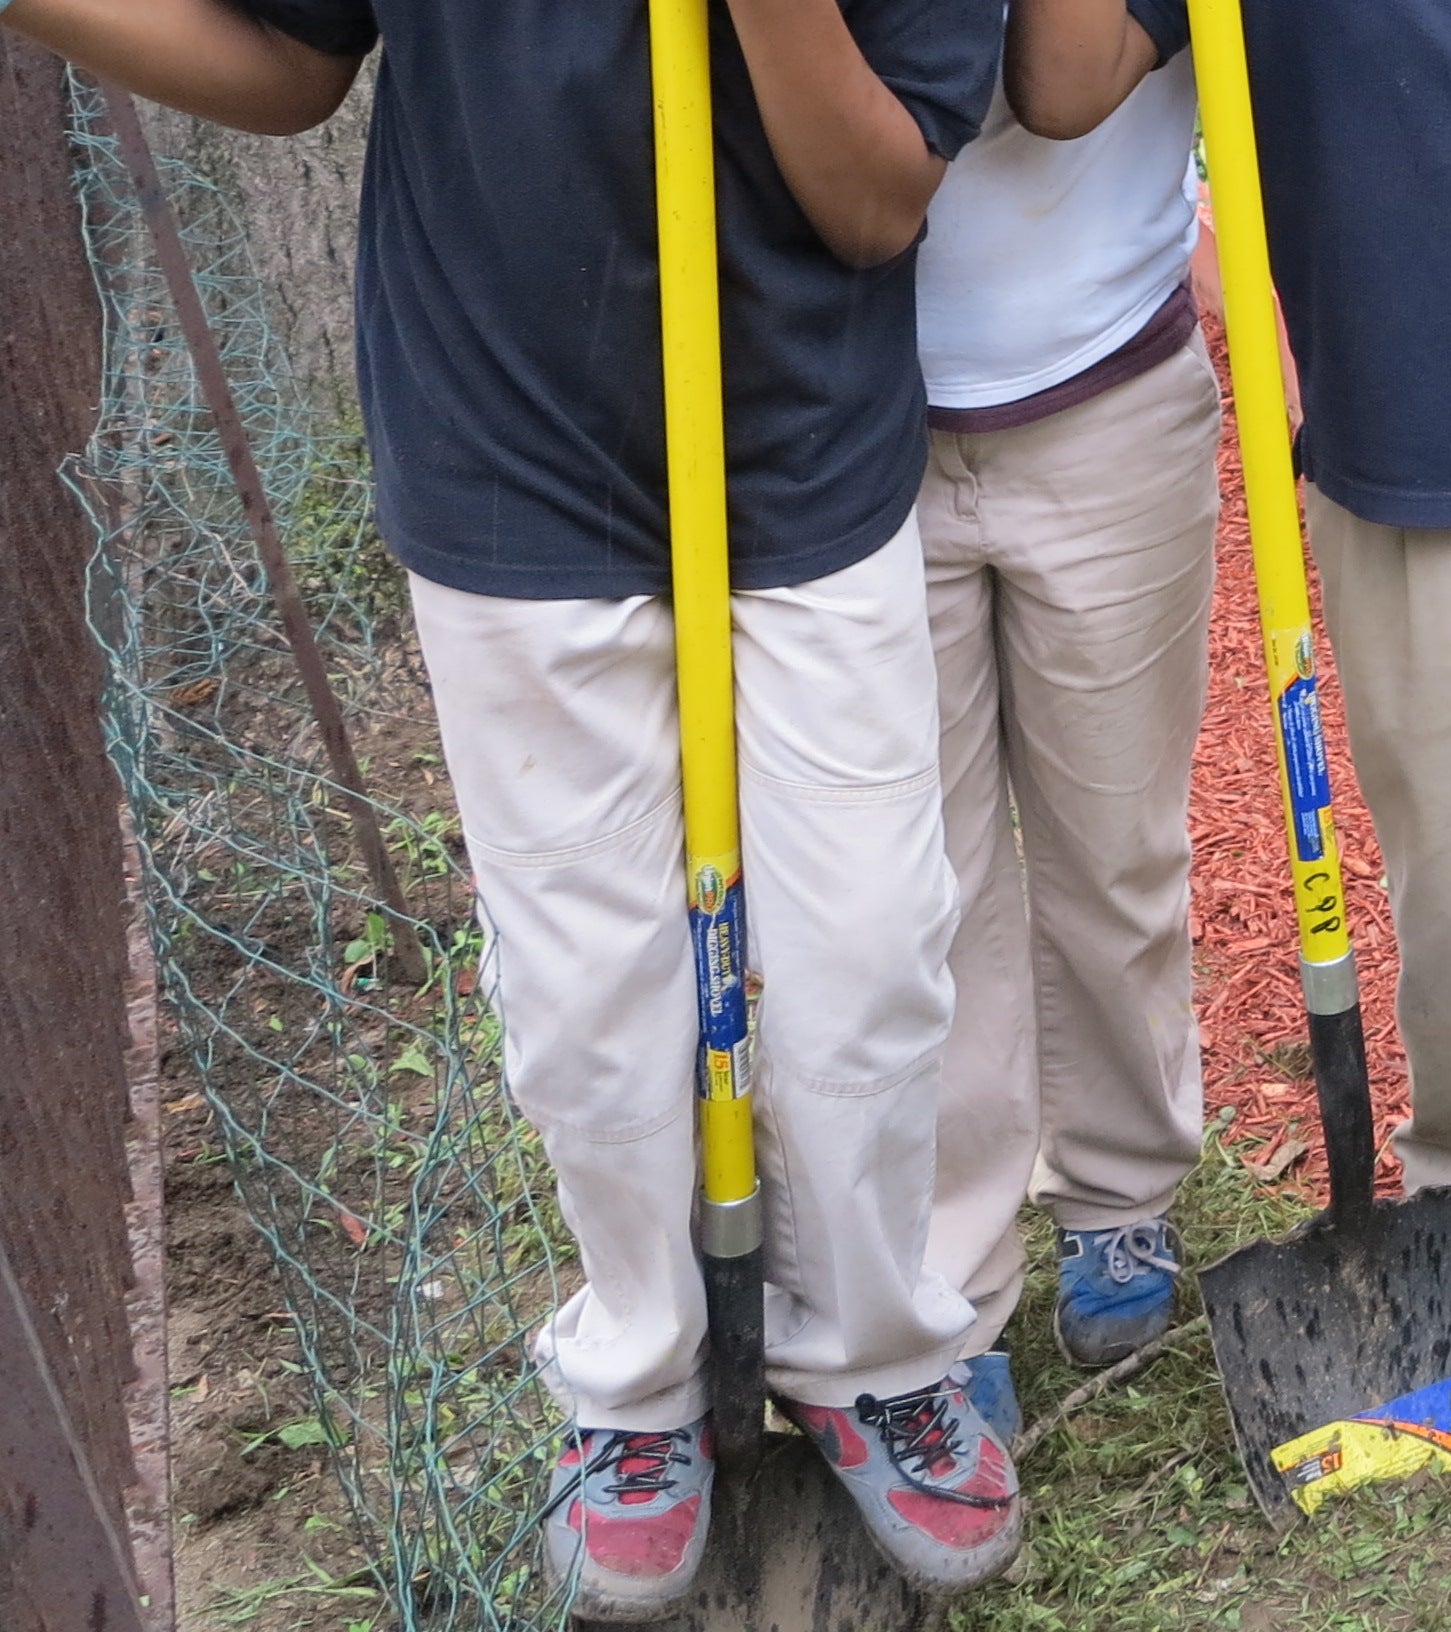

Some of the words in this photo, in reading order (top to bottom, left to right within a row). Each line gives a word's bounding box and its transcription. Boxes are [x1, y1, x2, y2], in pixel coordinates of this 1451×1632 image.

[707, 927, 720, 973] DIGGING
[709, 974, 723, 1015] SHOVEL
[714, 1054, 729, 1070] 15
[1320, 1452, 1341, 1474] 15
